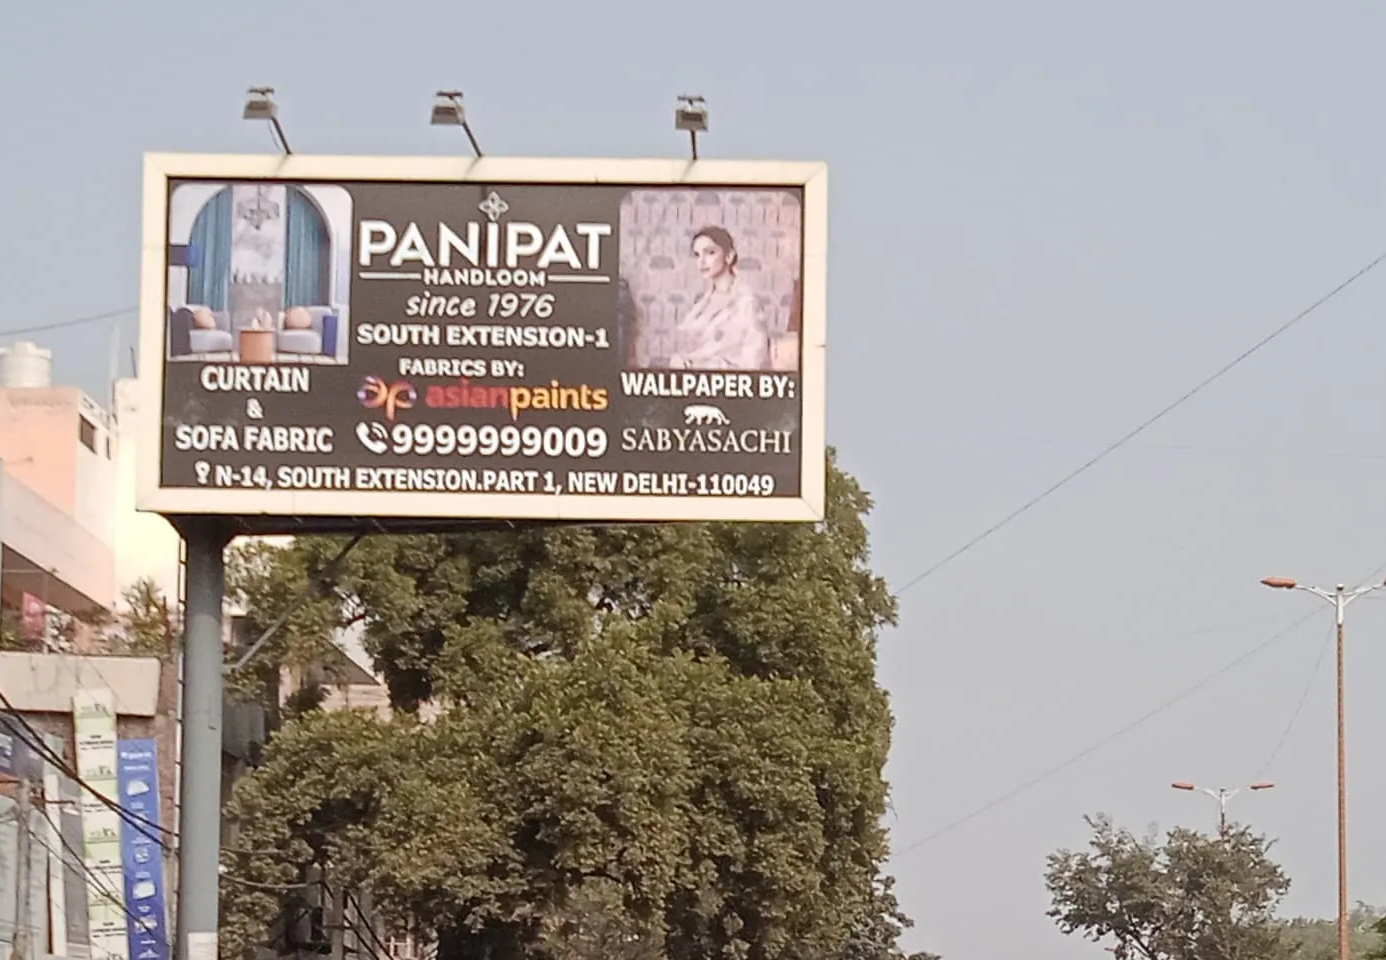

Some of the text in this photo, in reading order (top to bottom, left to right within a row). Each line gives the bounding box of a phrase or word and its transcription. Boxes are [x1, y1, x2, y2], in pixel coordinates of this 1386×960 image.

[358, 220, 612, 270] PANIPAT
[424, 269, 546, 288] HANDLOOM
[405, 291, 555, 320] since 1976
[357, 324, 610, 349] SOUTH EXTENSION-1
[201, 368, 310, 393] CURTAIN
[399, 358, 525, 378] FABRICS BY:
[621, 373, 796, 398] WALLPAPER BY:
[246, 399, 264, 420] &
[175, 426, 334, 453] SOFA FABRIC
[392, 425, 609, 458] 9999999009
[621, 428, 792, 454] SABYASACHI
[216, 467, 272, 491] N-14,
[278, 468, 350, 490] SOUTH
[568, 472, 615, 493] NEW
[622, 473, 774, 497] DELHI-110049
